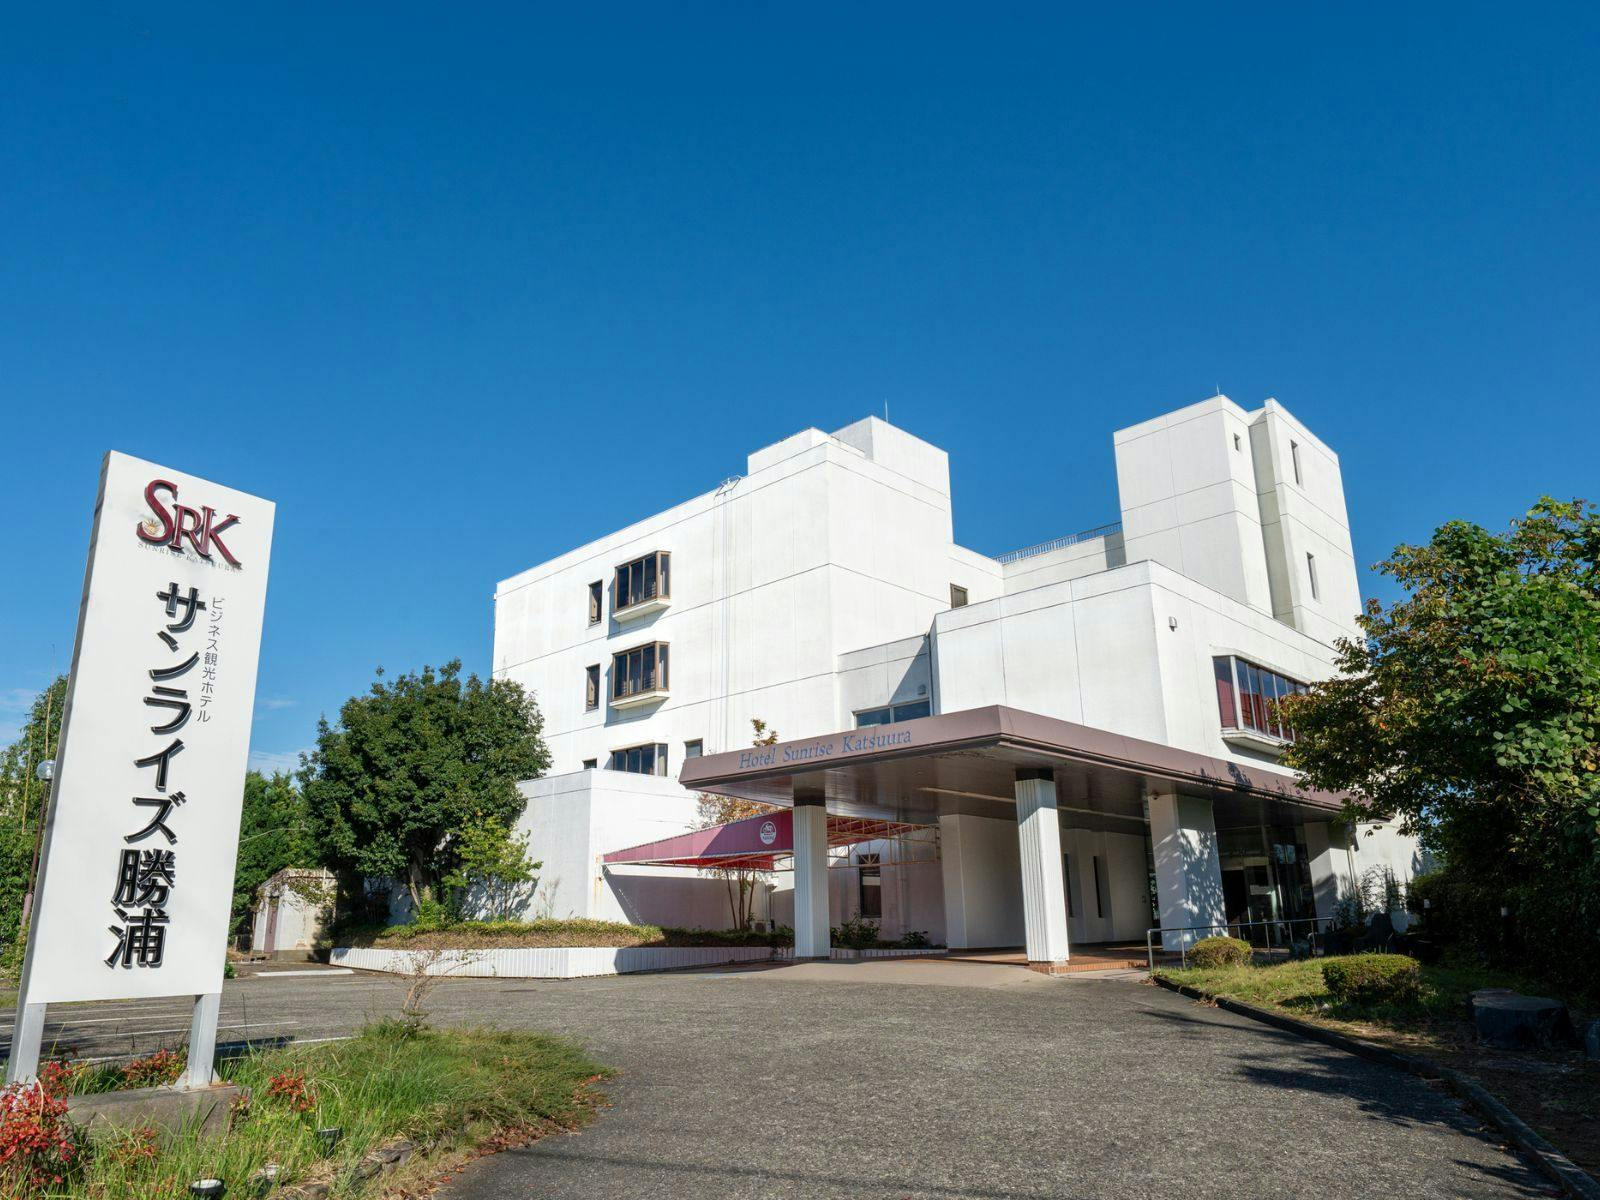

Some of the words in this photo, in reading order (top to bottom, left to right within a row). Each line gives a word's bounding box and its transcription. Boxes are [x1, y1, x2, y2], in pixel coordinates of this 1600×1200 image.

[136, 479, 242, 569] SRK
[196, 596, 225, 723] ビジネス観光ホテル
[104, 582, 207, 969] サンライズ勝浦
[738, 746, 777, 769] Hotel
[783, 741, 834, 763] Sunrise
[842, 729, 913, 753] Katsuura
